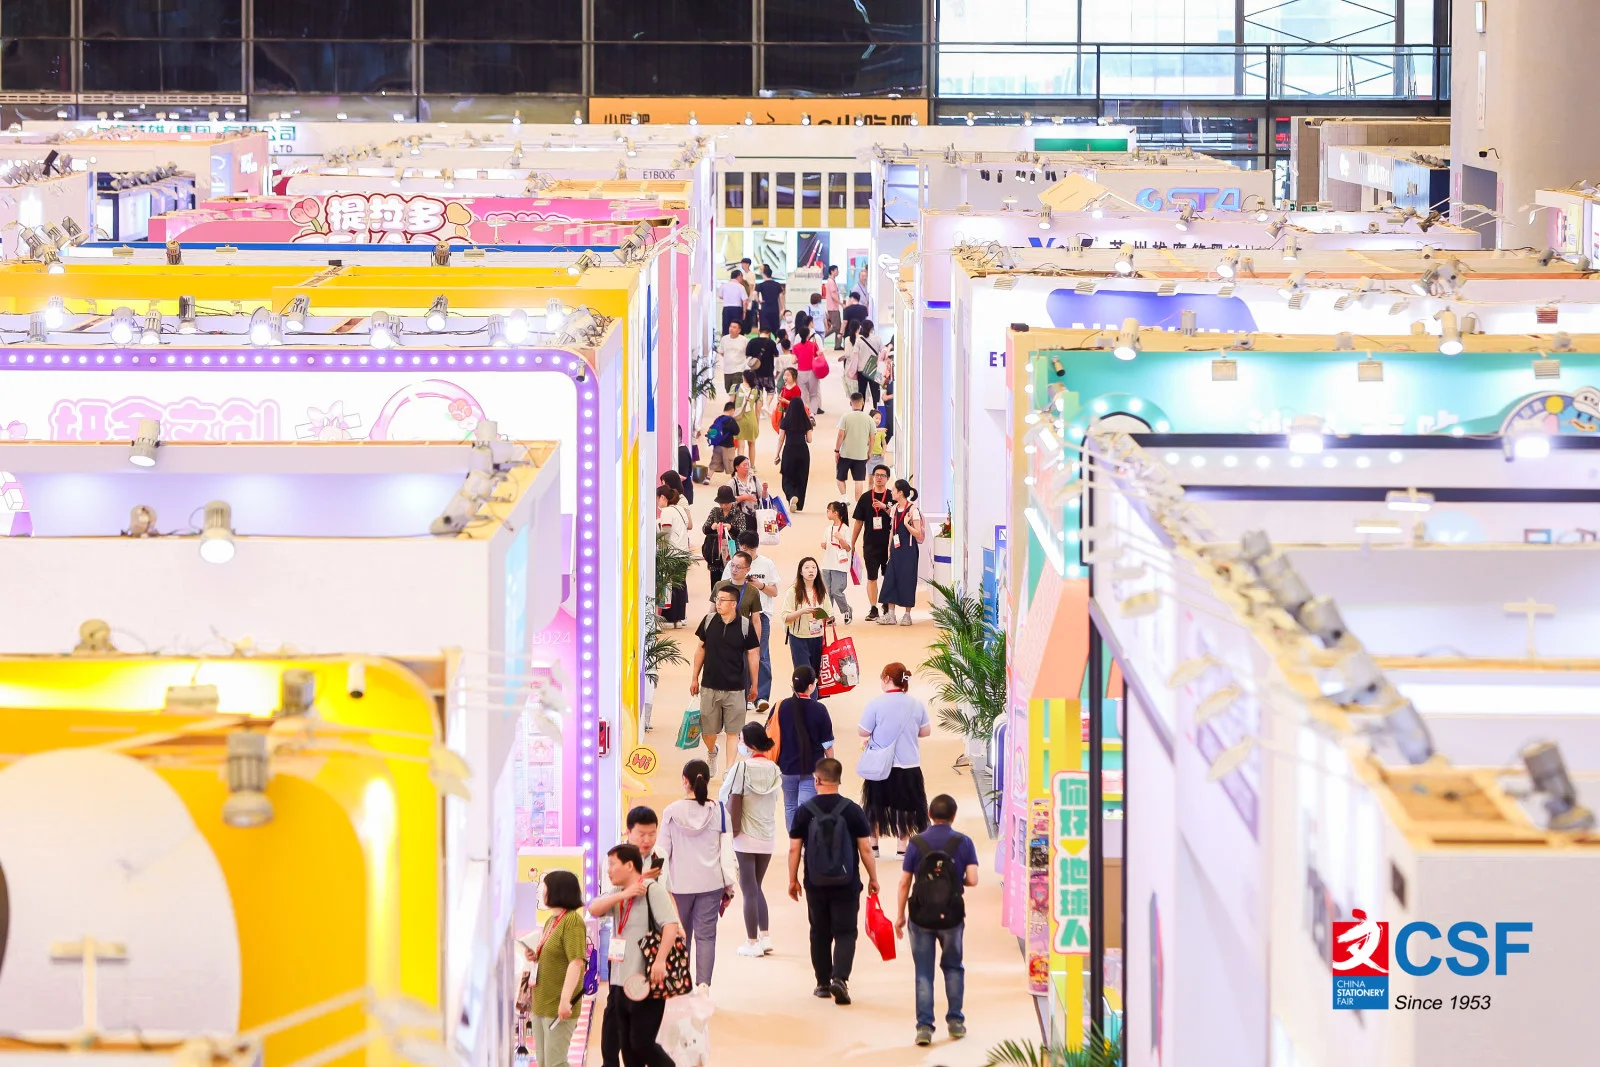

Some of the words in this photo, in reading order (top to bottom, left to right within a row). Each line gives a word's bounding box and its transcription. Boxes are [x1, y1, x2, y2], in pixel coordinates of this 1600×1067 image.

[272, 145, 294, 153] LTD
[642, 170, 676, 180] E1B006
[632, 752, 653, 771] Hi
